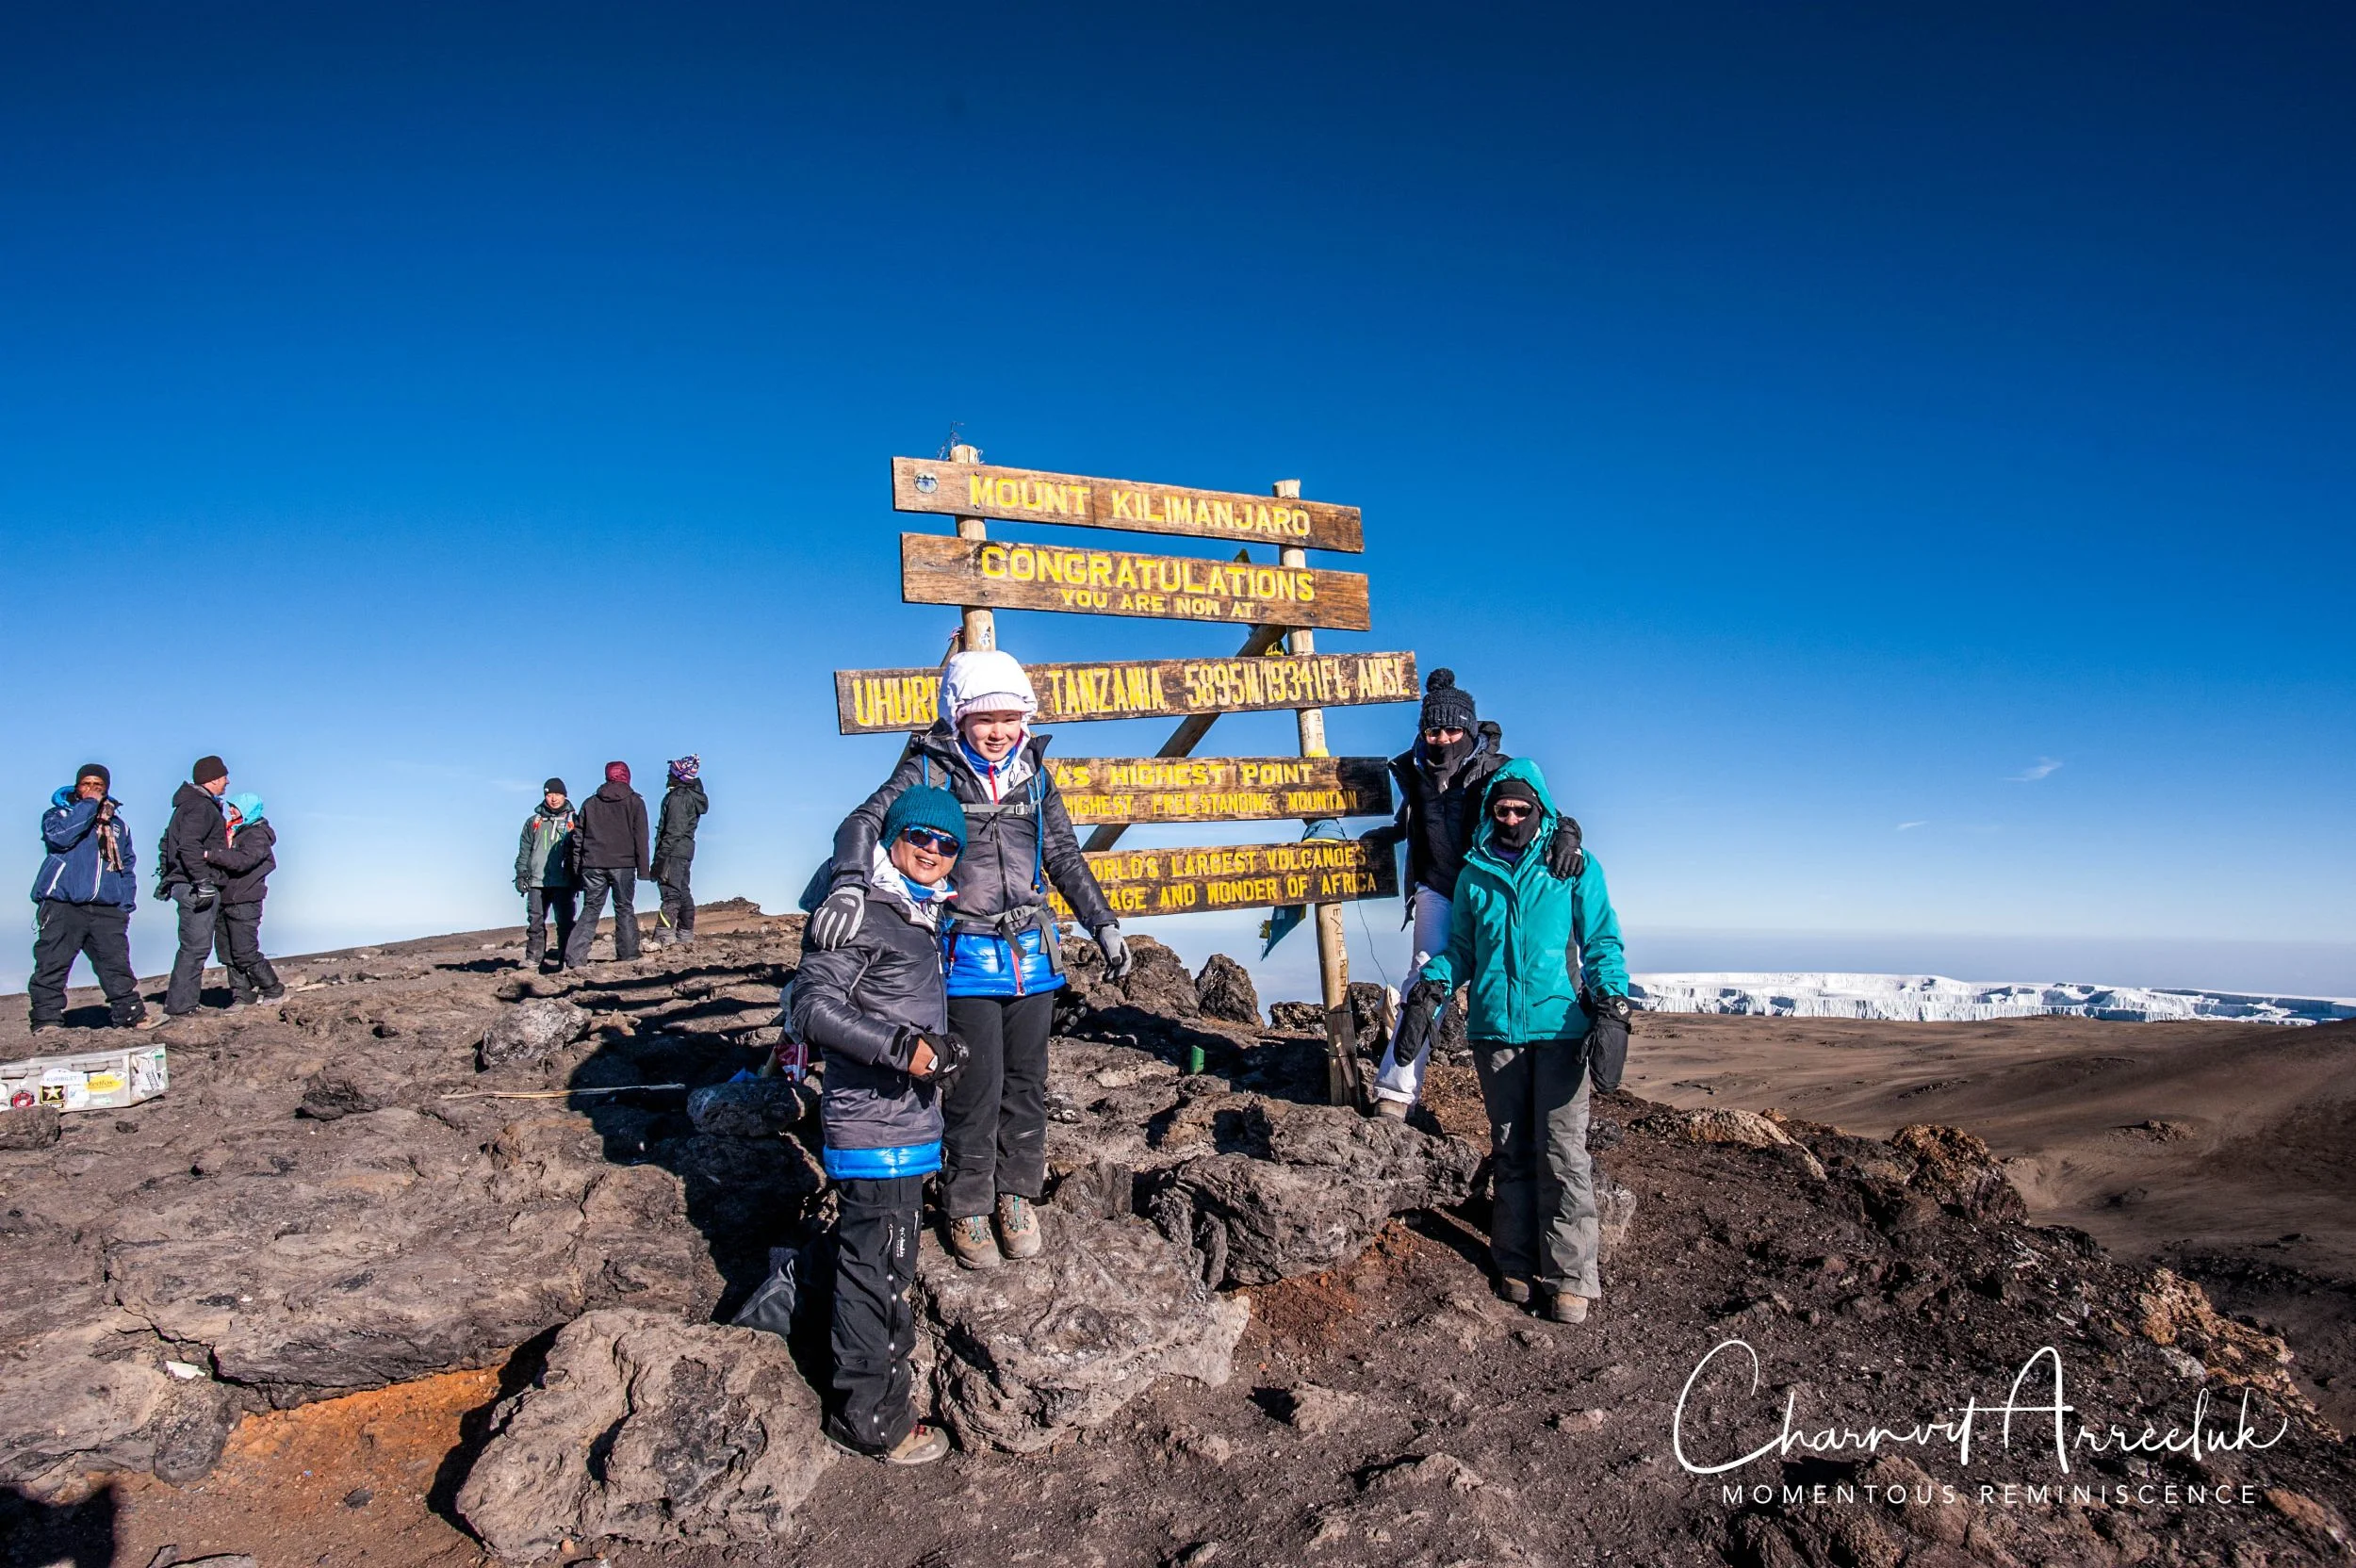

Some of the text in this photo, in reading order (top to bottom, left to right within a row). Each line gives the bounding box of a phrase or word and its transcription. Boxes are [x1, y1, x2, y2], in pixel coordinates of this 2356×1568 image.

[969, 474, 1311, 537] MOUNT KILIMANJARO
[981, 545, 1316, 602] CONGRATULATIONS
[1060, 588, 1256, 619] YOU ARE NOW AT
[1357, 657, 1410, 699] AMSL
[1110, 763, 1227, 787] HIGHEST
[1241, 762, 1315, 786] POINT
[1287, 789, 1358, 811] MOUNTAIN
[1170, 850, 1257, 878] LARGEST
[1265, 845, 1366, 873] VOLCANOES
[1158, 881, 1197, 908] AND
[1206, 877, 1278, 905] WONDER
[1286, 874, 1309, 899] OF
[1321, 871, 1378, 896] AFRICA
